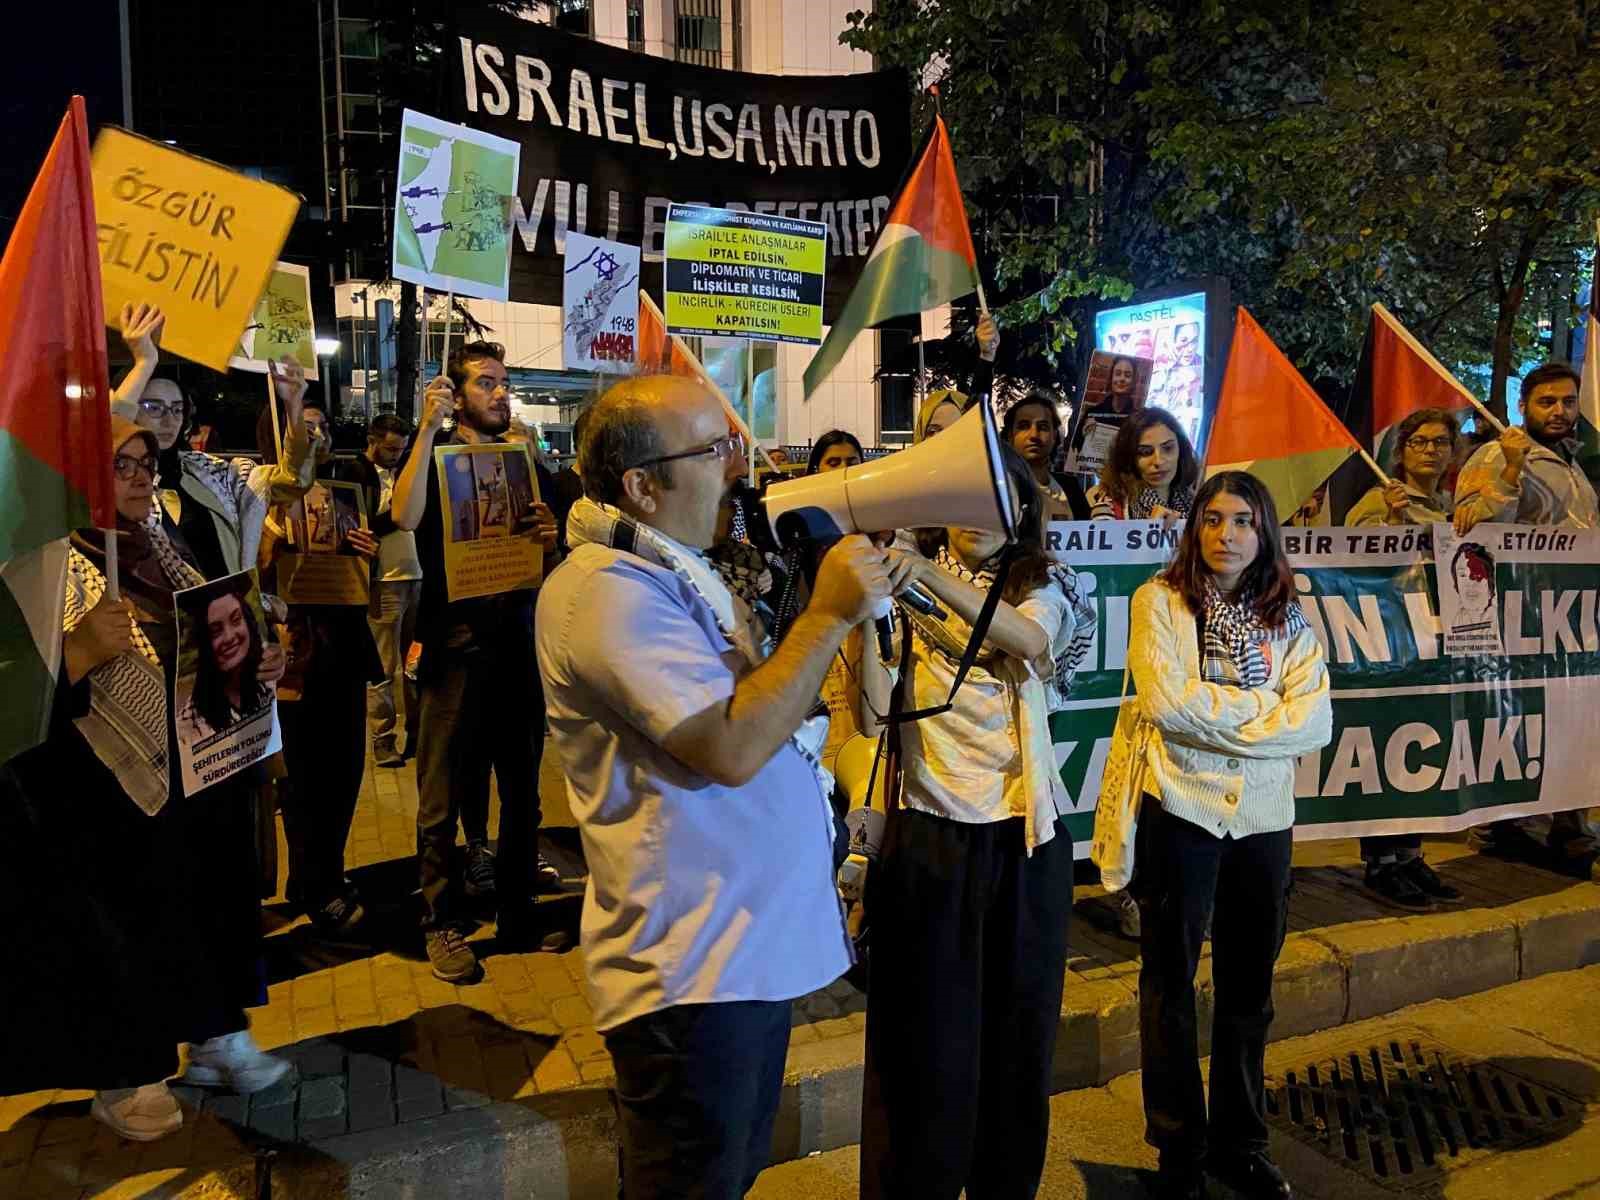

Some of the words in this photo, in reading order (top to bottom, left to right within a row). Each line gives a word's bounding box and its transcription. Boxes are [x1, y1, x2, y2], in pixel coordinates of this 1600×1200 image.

[111, 168, 236, 240] ÖZGÜR
[709, 244, 741, 260] İPTAL
[744, 249, 788, 266] EDİLSİN,
[691, 261, 756, 278] DİPLOMATİK
[760, 268, 770, 280] VE
[693, 277, 748, 294] İLİŞKİLER
[752, 283, 800, 301] KESİLSİN,
[715, 315, 781, 329] KAPATILSIN!
[1285, 531, 1332, 554] BİR
